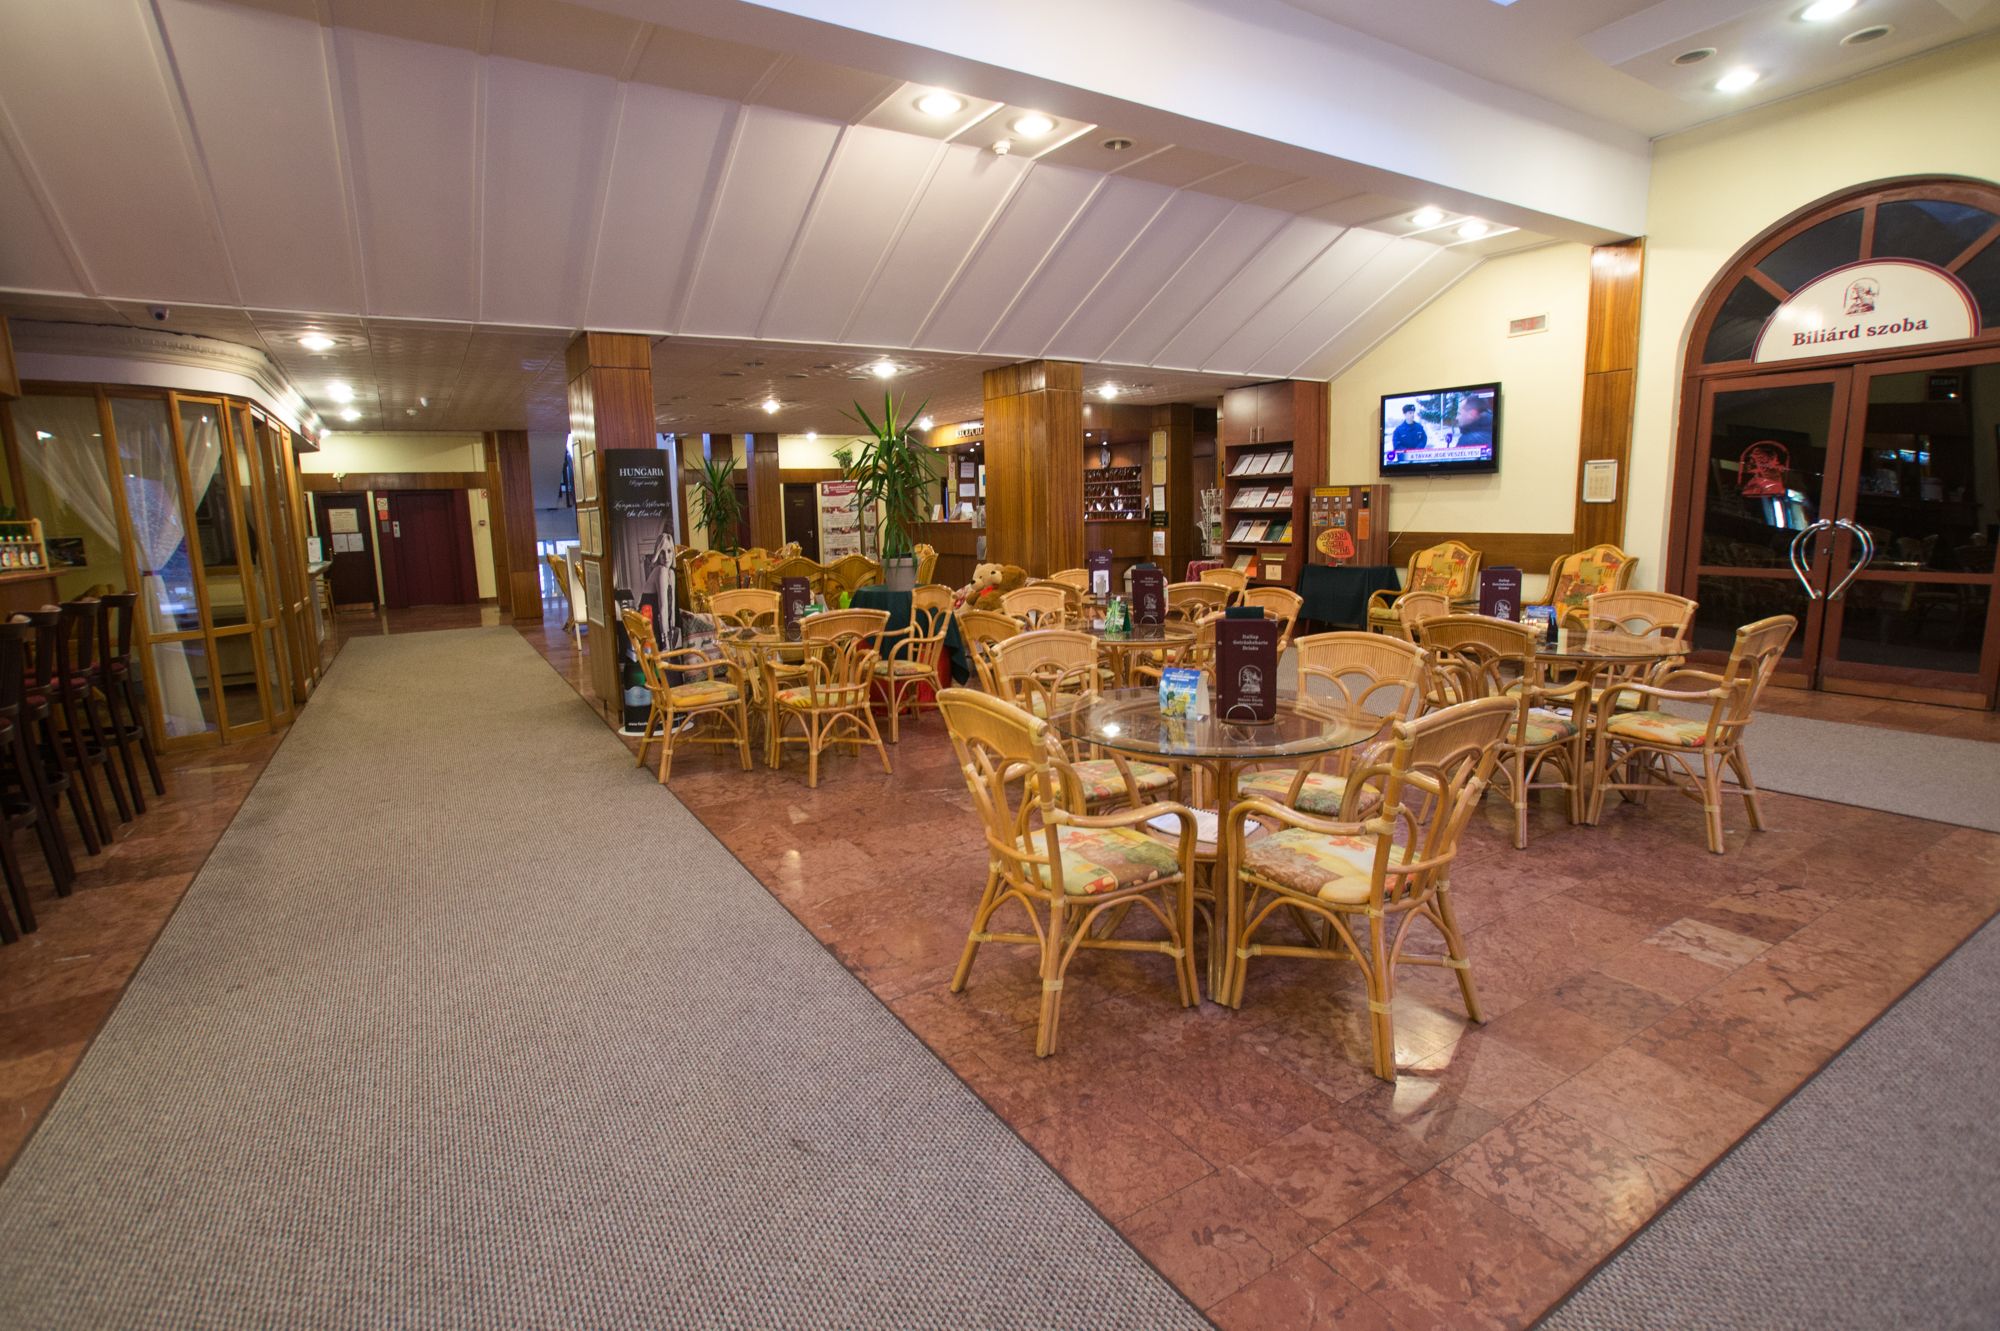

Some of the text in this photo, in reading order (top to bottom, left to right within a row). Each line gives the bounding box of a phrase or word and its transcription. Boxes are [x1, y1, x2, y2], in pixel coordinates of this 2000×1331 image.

[1792, 318, 1929, 346] Biliárd szoba
[619, 467, 664, 477] HUNGARIA
